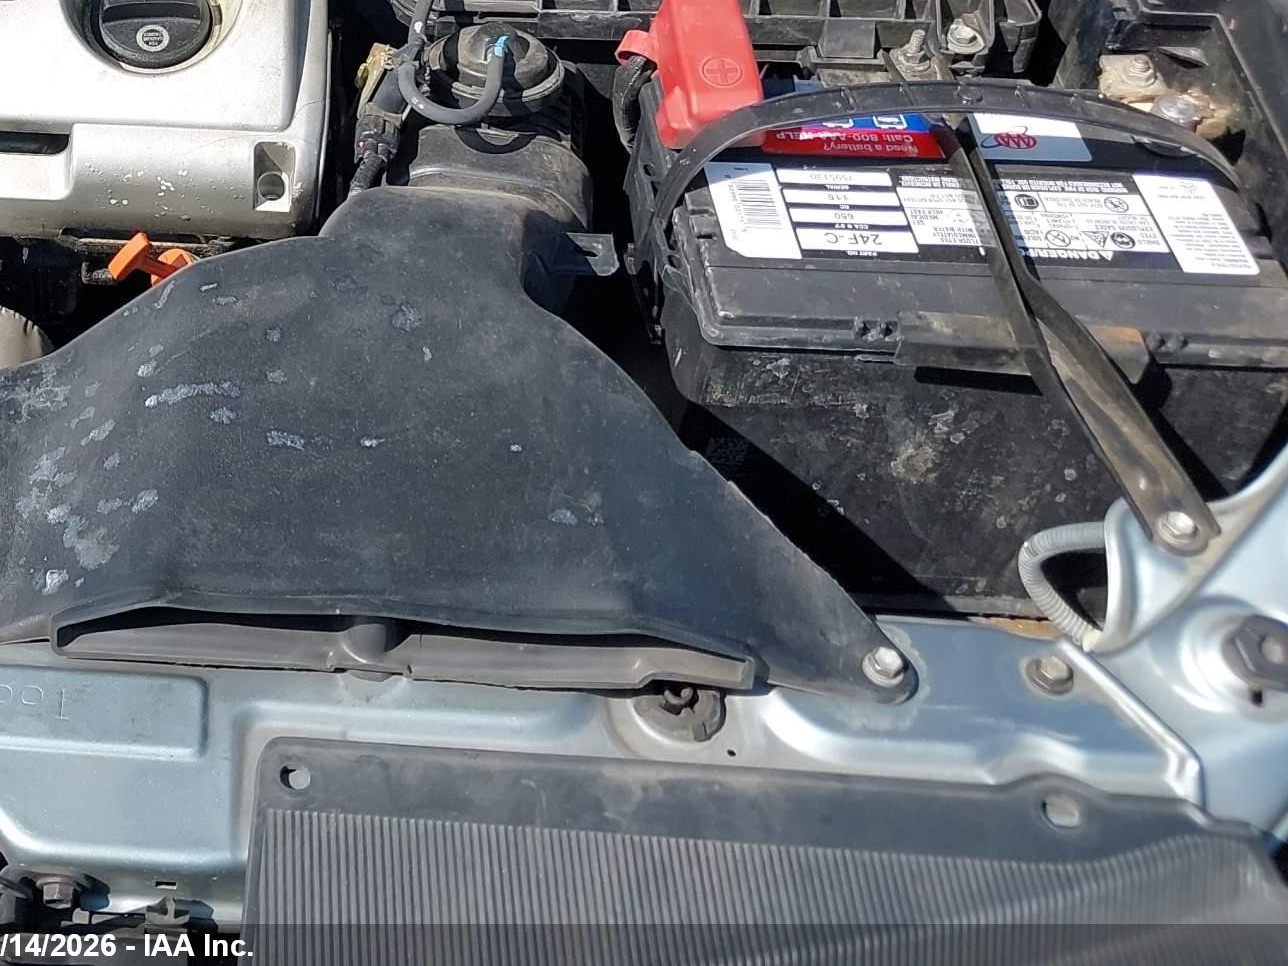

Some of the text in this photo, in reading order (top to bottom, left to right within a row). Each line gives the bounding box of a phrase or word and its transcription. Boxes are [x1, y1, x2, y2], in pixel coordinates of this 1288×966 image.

[883, 133, 912, 143] Call:
[1000, 136, 1031, 147] AAA
[823, 142, 872, 153] battery?
[824, 233, 882, 245] 24F-C
